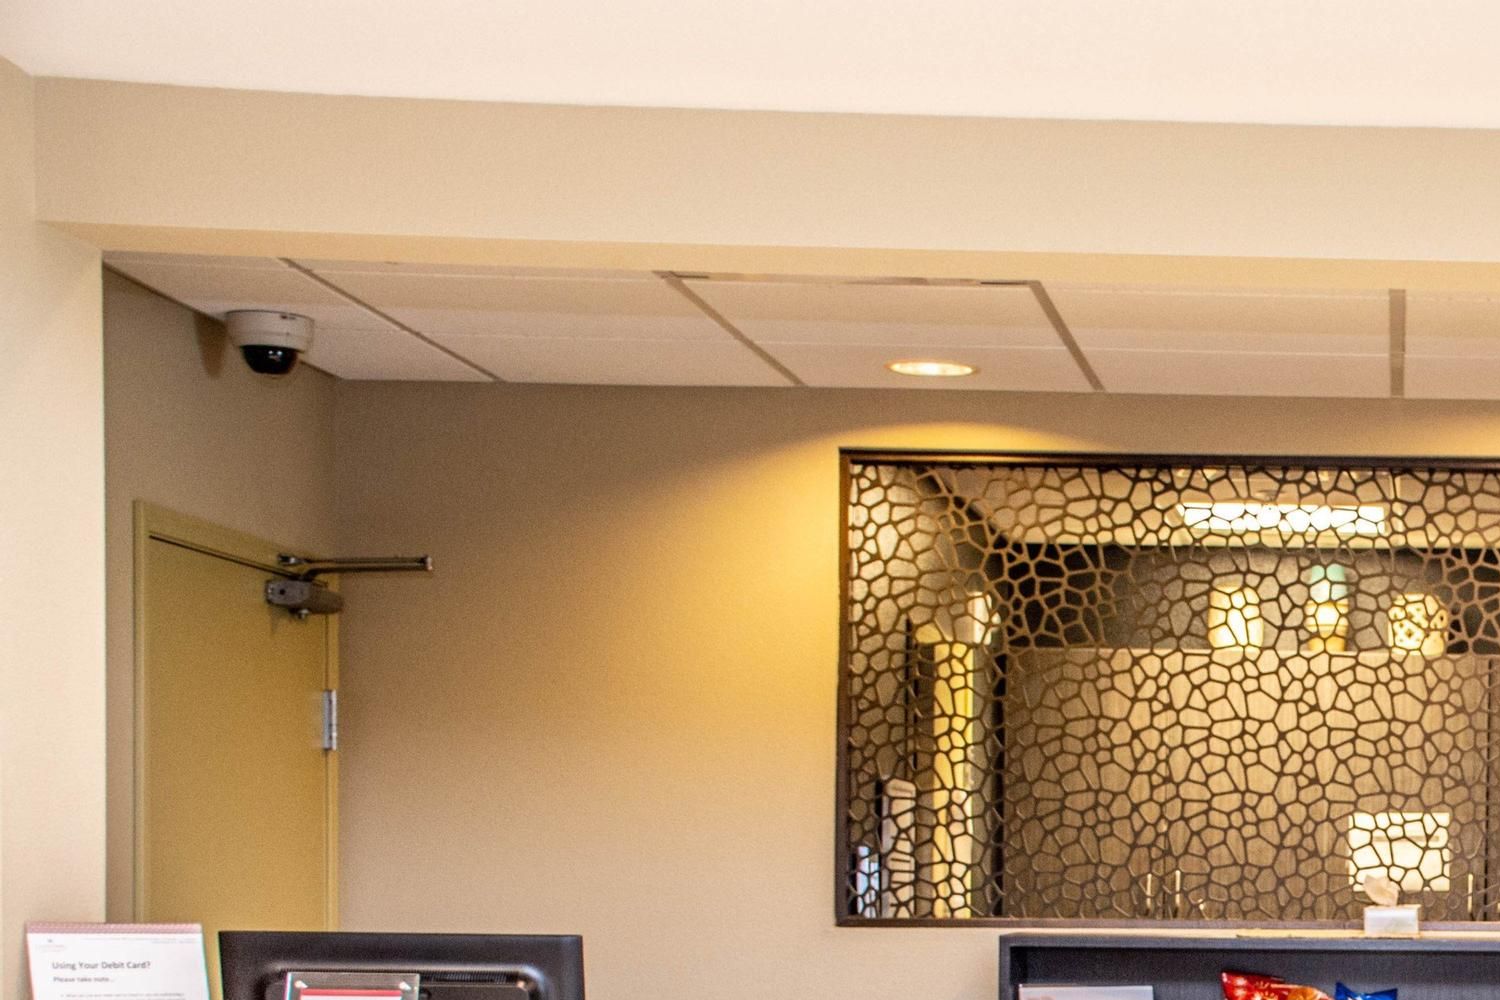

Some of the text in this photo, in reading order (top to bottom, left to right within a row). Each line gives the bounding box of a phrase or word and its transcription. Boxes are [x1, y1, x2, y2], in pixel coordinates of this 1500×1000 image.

[52, 960, 151, 971] Using Your Debit Card?
